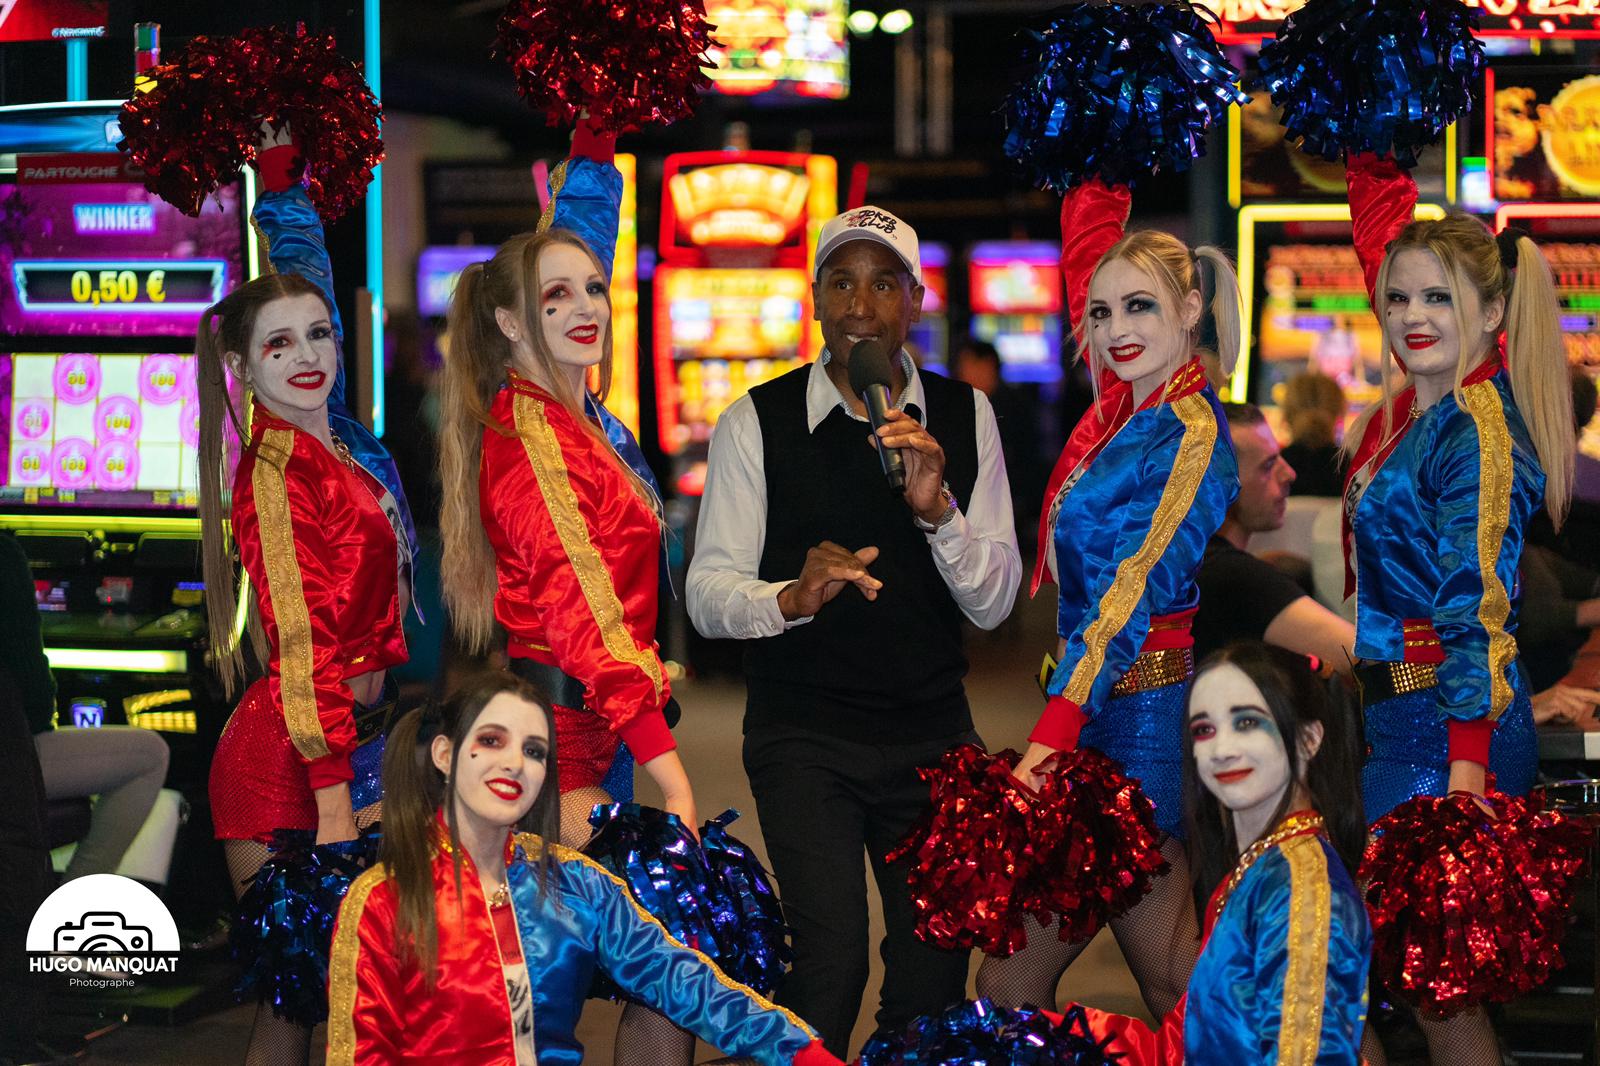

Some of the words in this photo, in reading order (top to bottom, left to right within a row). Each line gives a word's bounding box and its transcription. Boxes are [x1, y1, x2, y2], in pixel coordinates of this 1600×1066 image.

[24, 166, 119, 179] PARTOUCHE
[77, 205, 153, 231] WINNER
[859, 217, 896, 233] CLUB
[71, 270, 138, 308] 0,50
[146, 270, 166, 302] €
